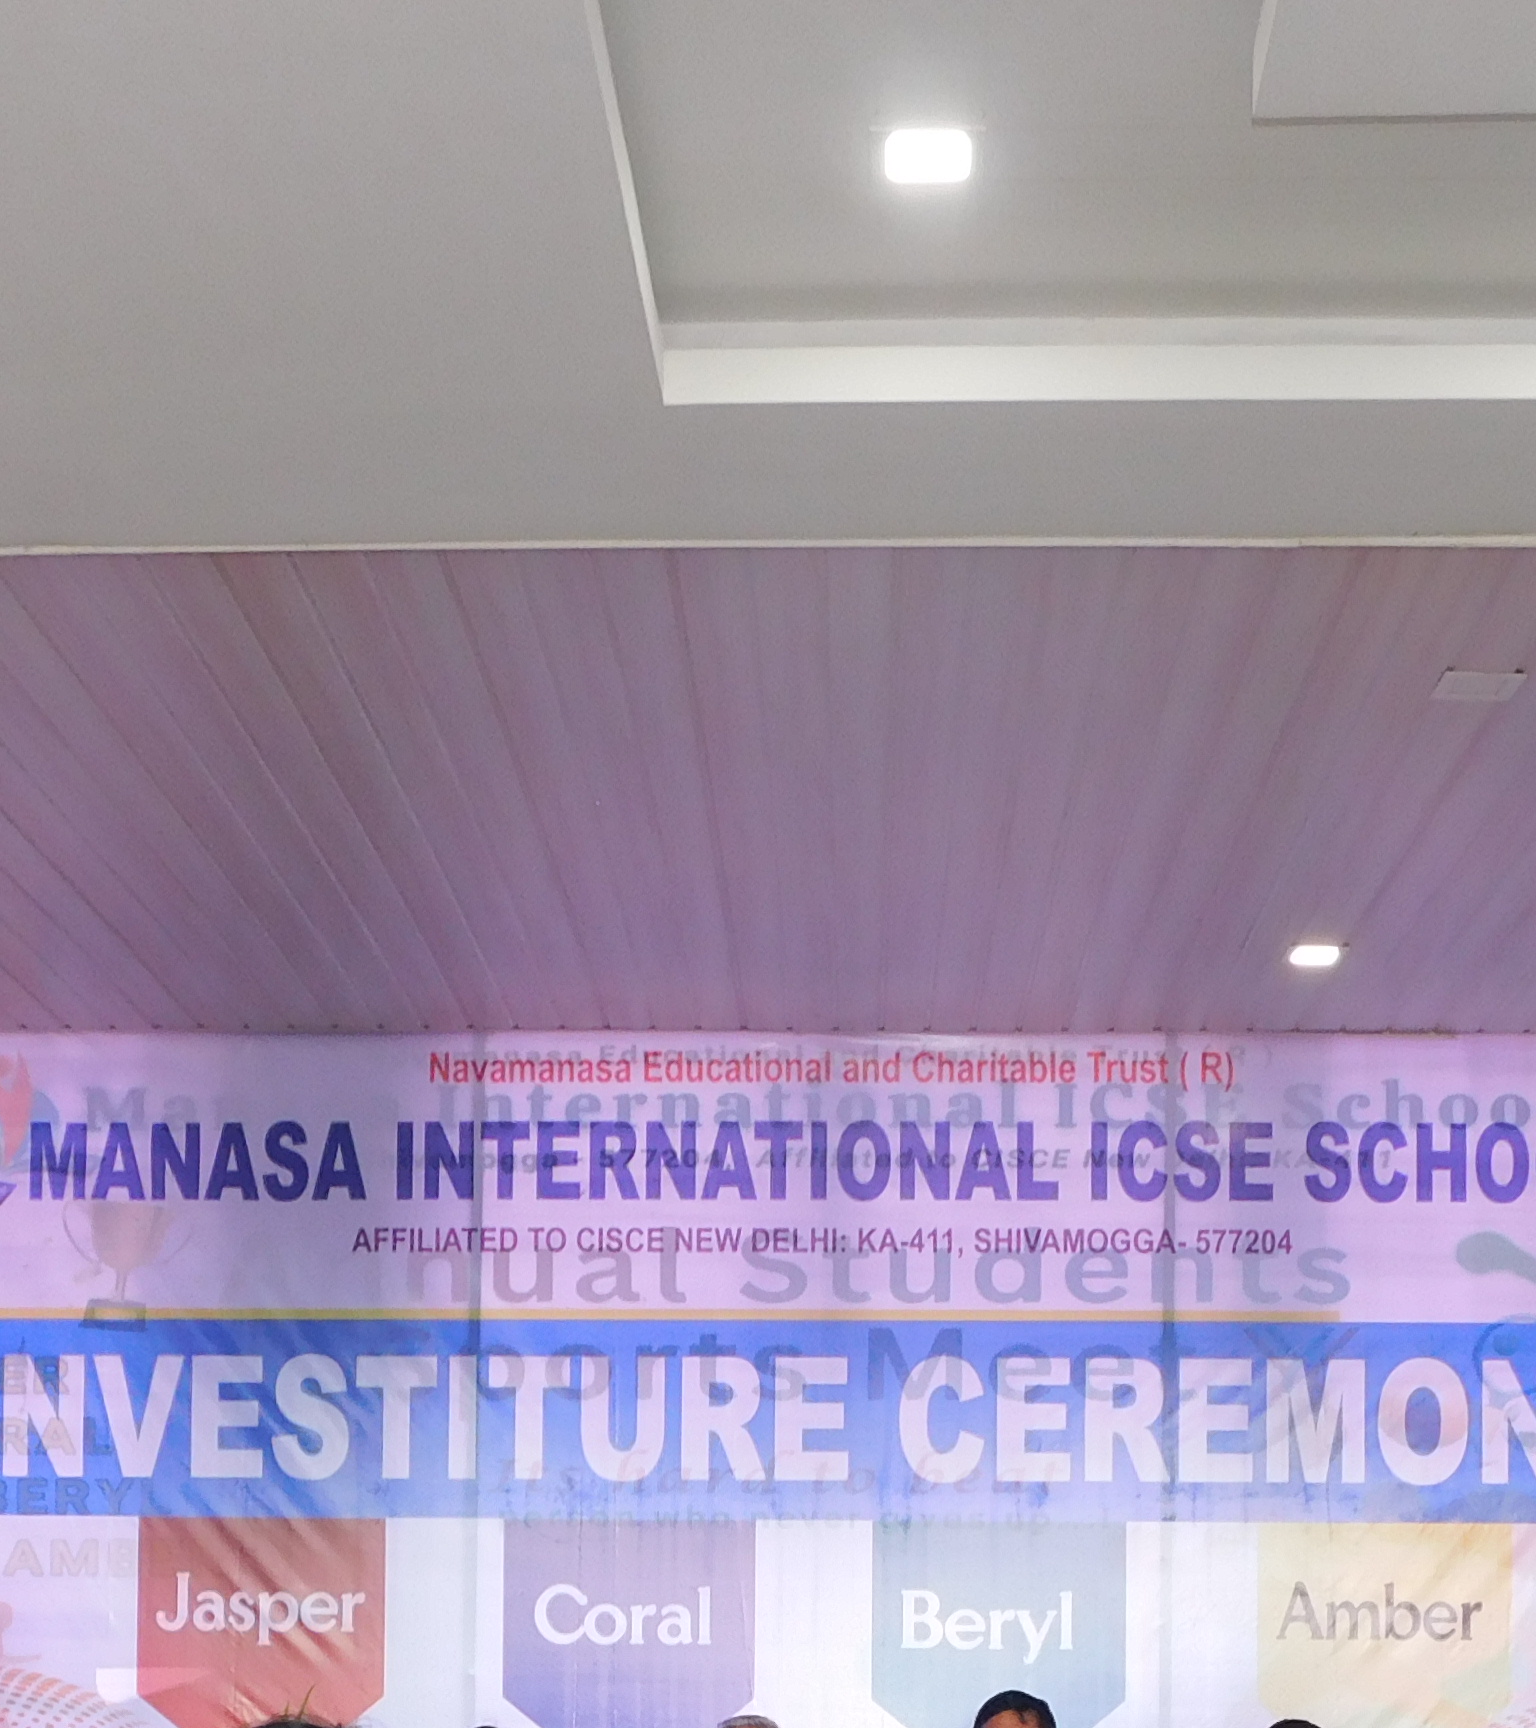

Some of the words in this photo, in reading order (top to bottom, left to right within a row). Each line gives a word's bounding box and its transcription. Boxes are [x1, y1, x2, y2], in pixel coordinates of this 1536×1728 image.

[429, 1051, 631, 1083] Navamanasa
[644, 1051, 831, 1083] Educational
[843, 1051, 900, 1083] and
[913, 1051, 1076, 1084] Charitable
[1087, 1051, 1169, 1083] Trust
[29, 1120, 366, 1201] MANASA
[396, 1120, 1060, 1201] INTERNATIONAL
[1090, 1120, 1275, 1202] ICSE
[352, 1226, 519, 1253] AFFILIATED
[528, 1226, 567, 1253] TO
[576, 1226, 663, 1253] CISCE
[674, 1226, 743, 1253] NEW
[751, 1227, 848, 1254] DELHI:
[857, 1227, 965, 1260] KA-411,
[973, 1226, 1188, 1256] SHIVAMOGGA-
[1195, 1226, 1294, 1256] 577204
[155, 1571, 367, 1647] Jasper
[533, 1583, 711, 1647] Coral
[900, 1589, 1075, 1664] Beryl
[1275, 1580, 1484, 1642] Amber
